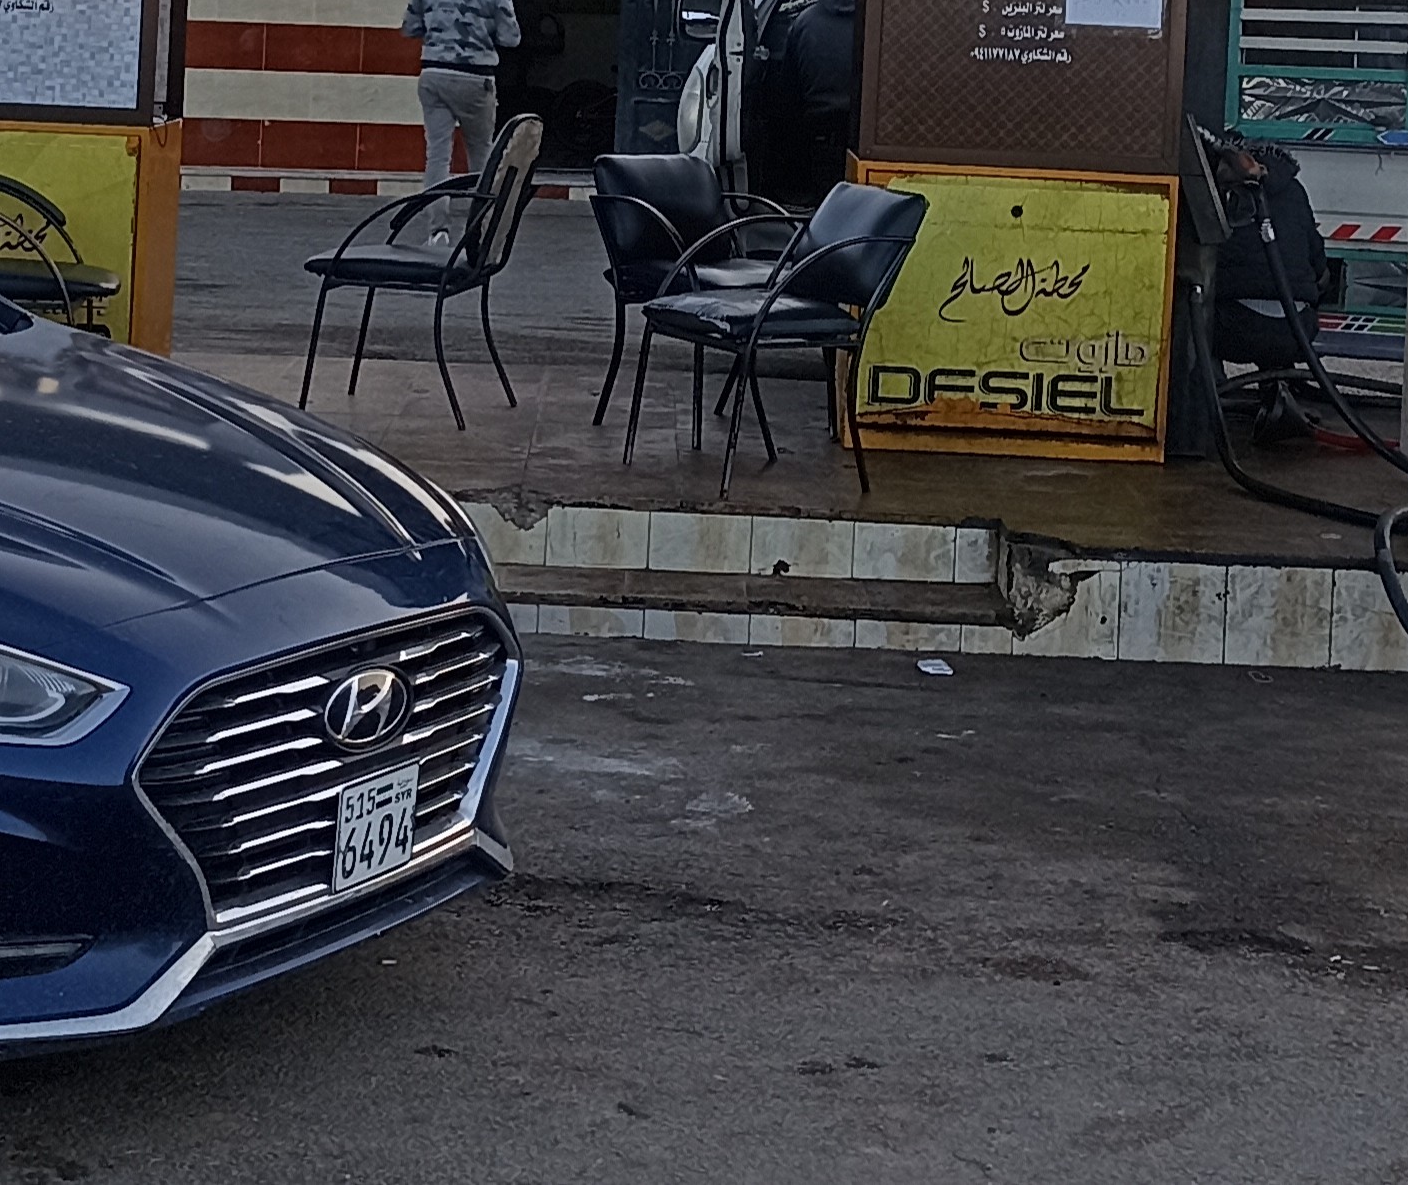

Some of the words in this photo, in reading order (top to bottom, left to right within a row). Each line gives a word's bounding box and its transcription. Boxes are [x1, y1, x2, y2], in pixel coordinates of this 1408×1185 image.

[39, 0, 54, 13] رقم
[1046, 5, 1063, 17] سعر
[1047, 30, 1065, 41] سعر
[1056, 48, 1072, 64] رقم
[1038, 259, 1090, 300] محطة
[938, 255, 1039, 323] الصالح
[393, 787, 413, 804] SYR
[344, 787, 377, 824] 515
[341, 807, 410, 880] 6494
